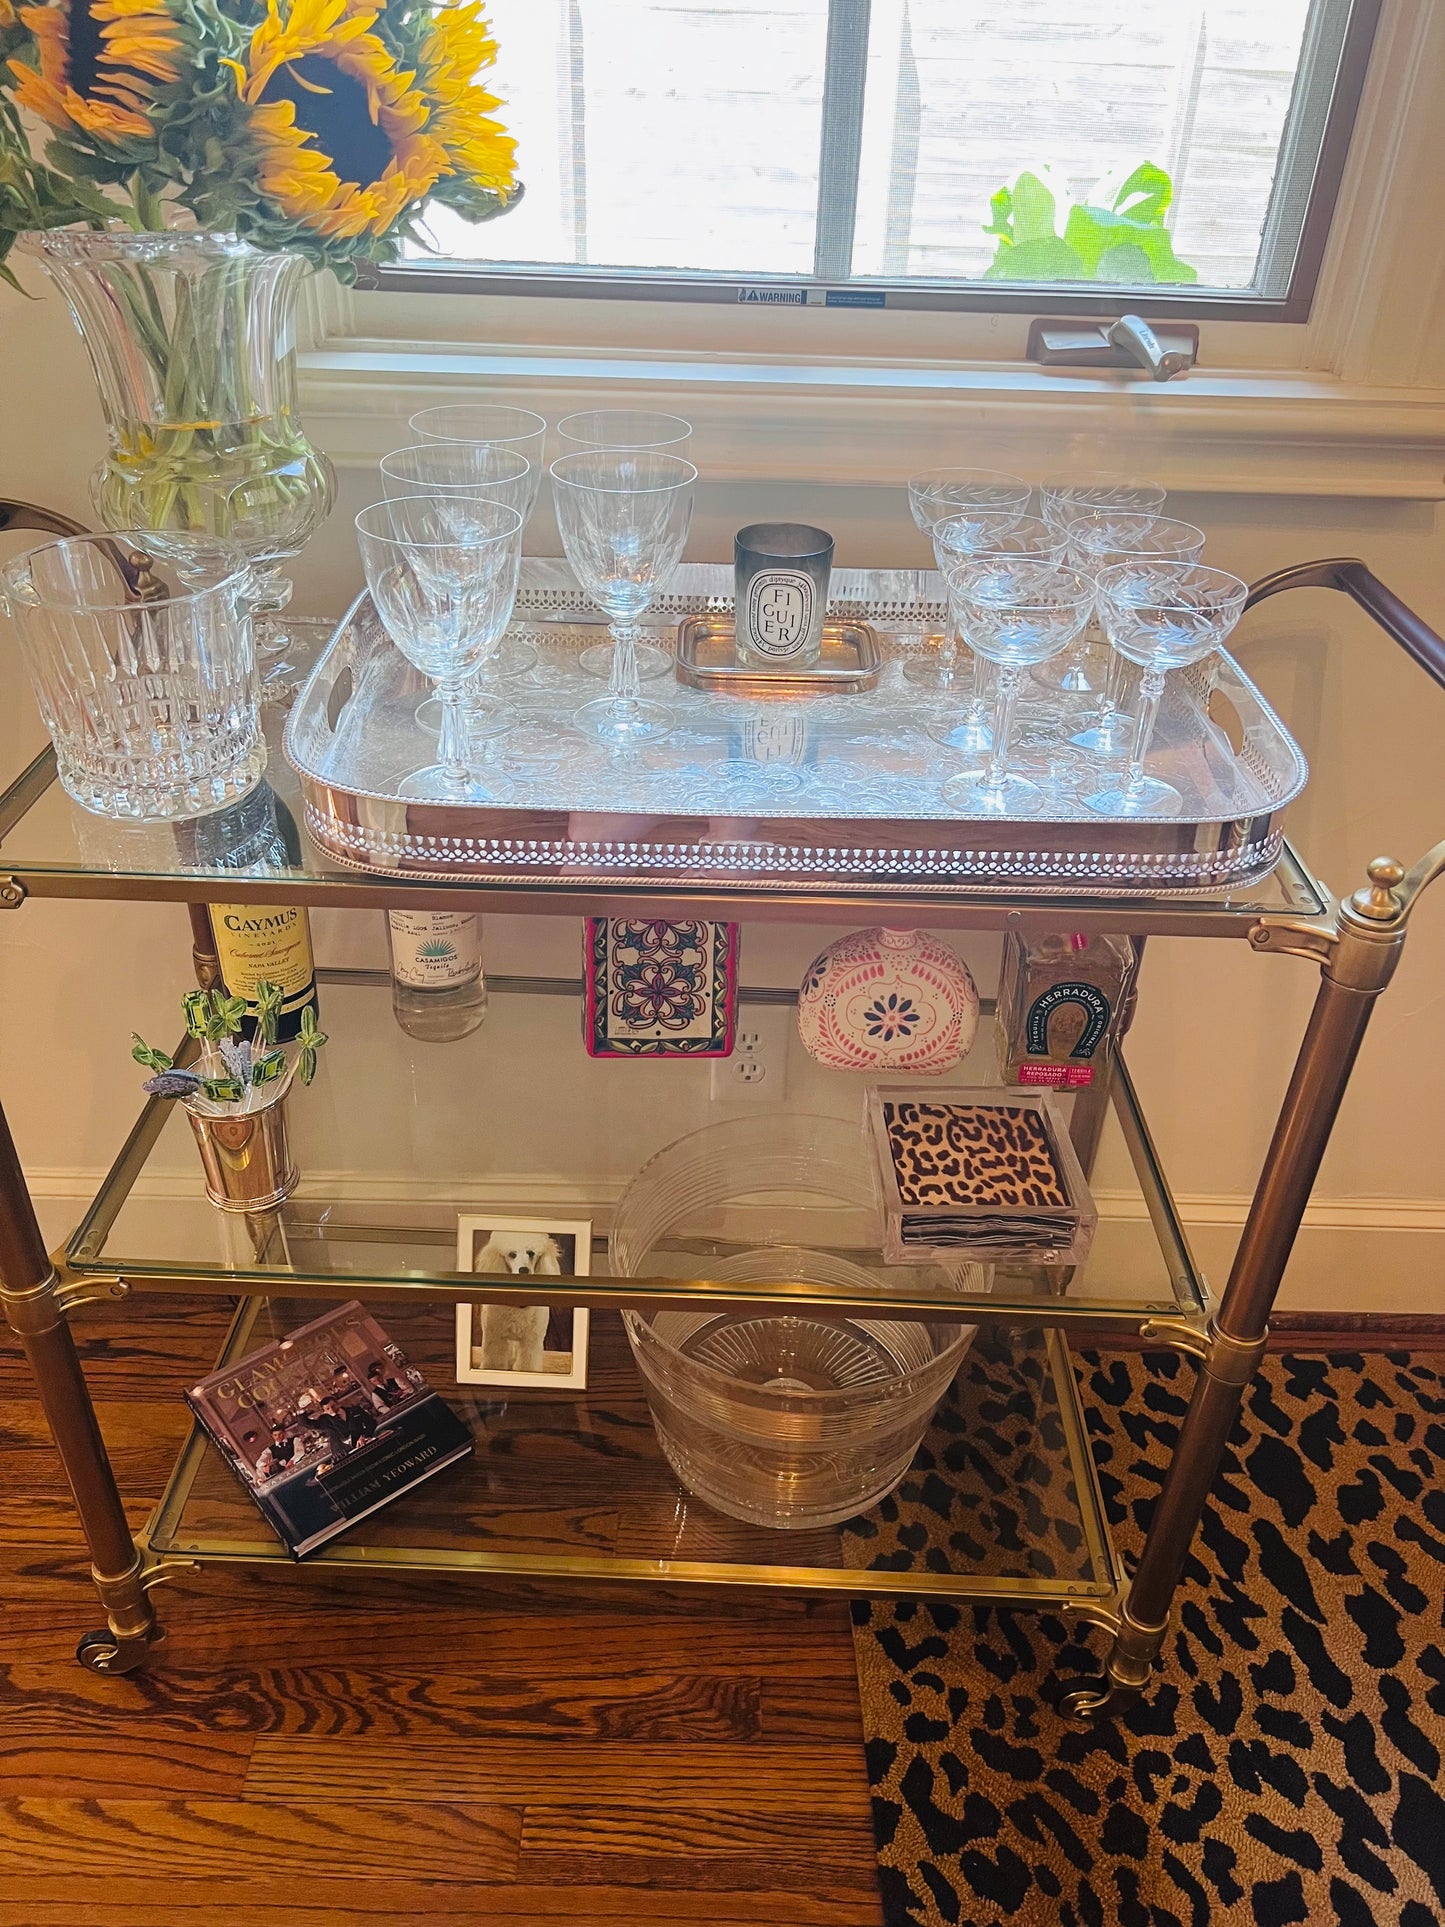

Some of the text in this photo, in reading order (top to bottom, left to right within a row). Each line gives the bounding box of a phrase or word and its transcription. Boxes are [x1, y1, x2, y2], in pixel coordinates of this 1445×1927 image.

[759, 291, 801, 303] WARNING
[224, 907, 297, 931] CAYMUS
[231, 922, 297, 938] VINEYARDS
[266, 957, 290, 968] VALLEY
[415, 954, 458, 963] CASAMIGOS
[425, 963, 450, 971] Tequila
[1039, 988, 1104, 1014] HERRADURA
[1032, 1015, 1040, 1043] TEQUILA
[1085, 1020, 1104, 1047] ORIGINAL
[329, 1479, 382, 1513] WILLIAM
[382, 1445, 438, 1481] YEOWARD
